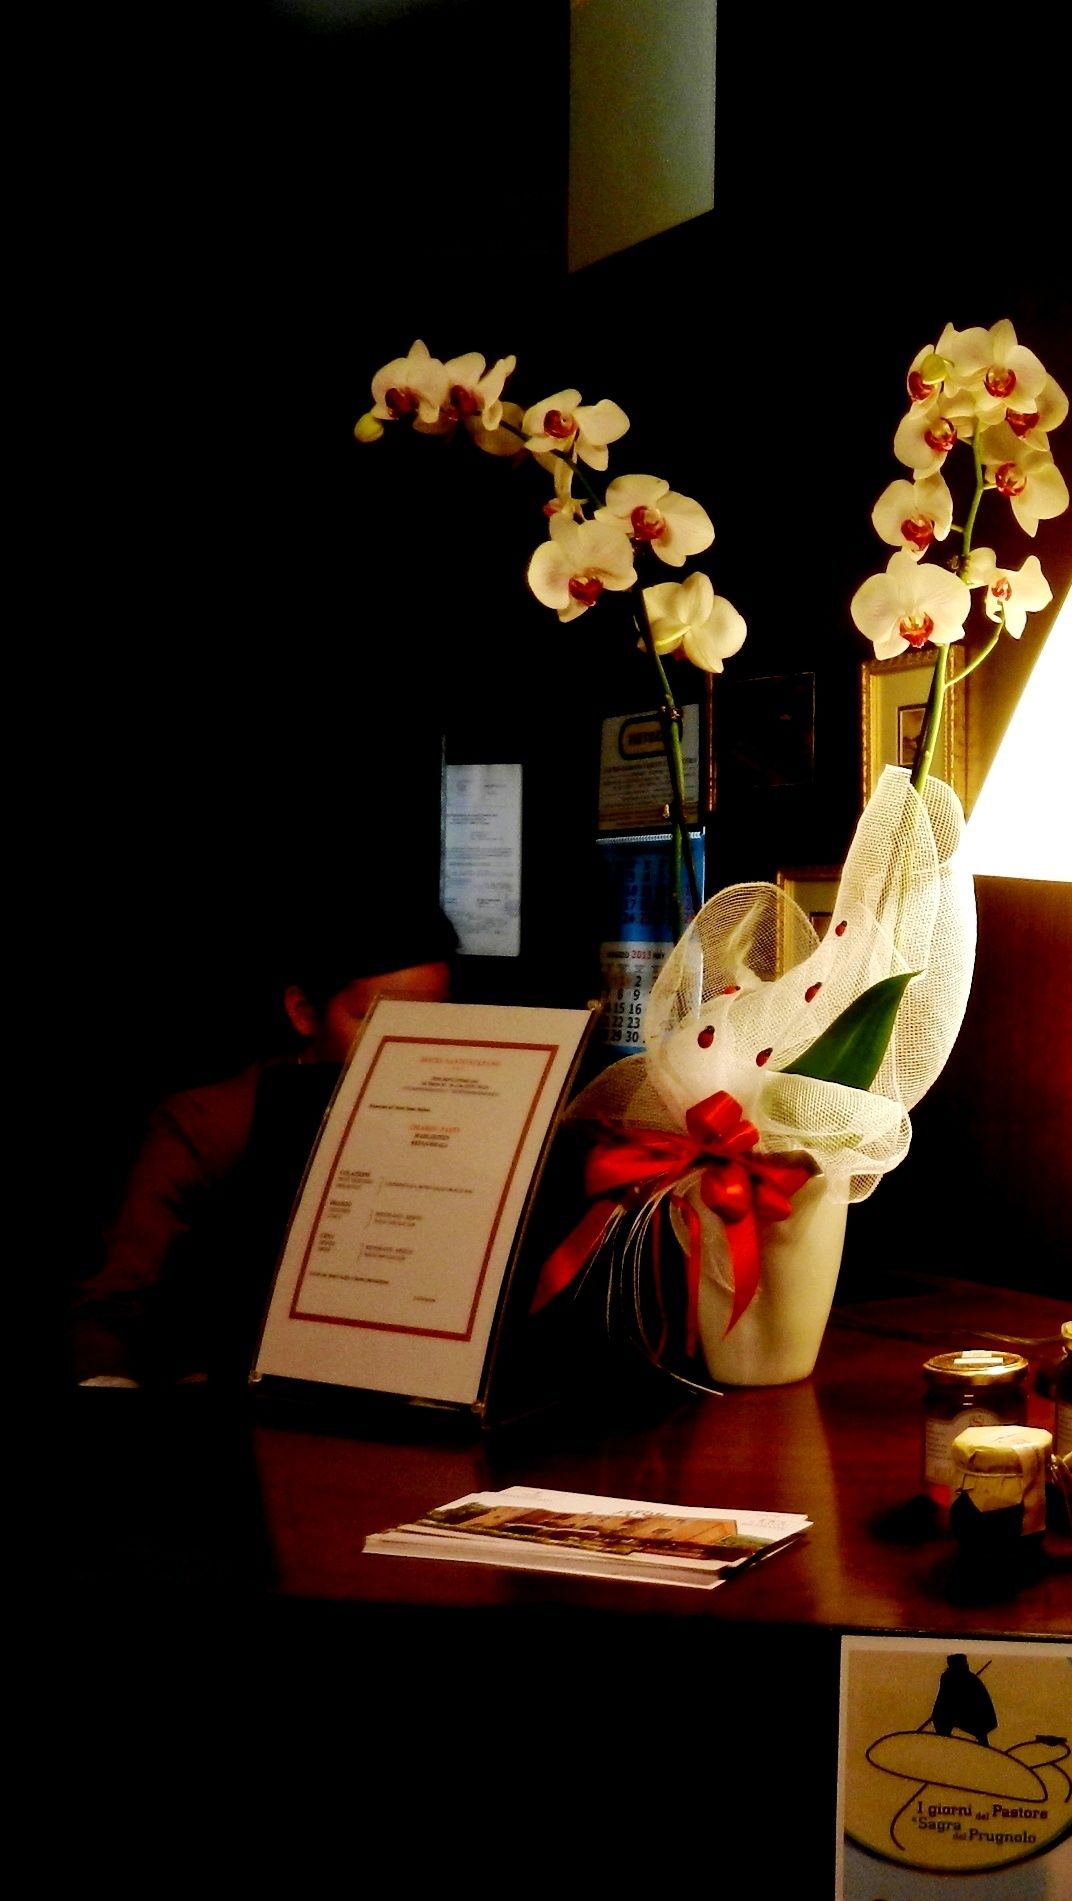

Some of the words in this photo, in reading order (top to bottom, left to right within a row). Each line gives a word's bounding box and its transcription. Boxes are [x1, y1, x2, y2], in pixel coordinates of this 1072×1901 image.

[614, 1002, 625, 1014] 15
[629, 1003, 642, 1015] 16
[627, 1017, 641, 1029] 23
[625, 1031, 639, 1043] 30
[917, 1801, 923, 1814] I
[928, 1803, 972, 1818] giorni
[992, 1804, 1048, 1819] Pastore
[918, 1817, 961, 1833] Sagra
[969, 1828, 1037, 1845] Prugnolo
